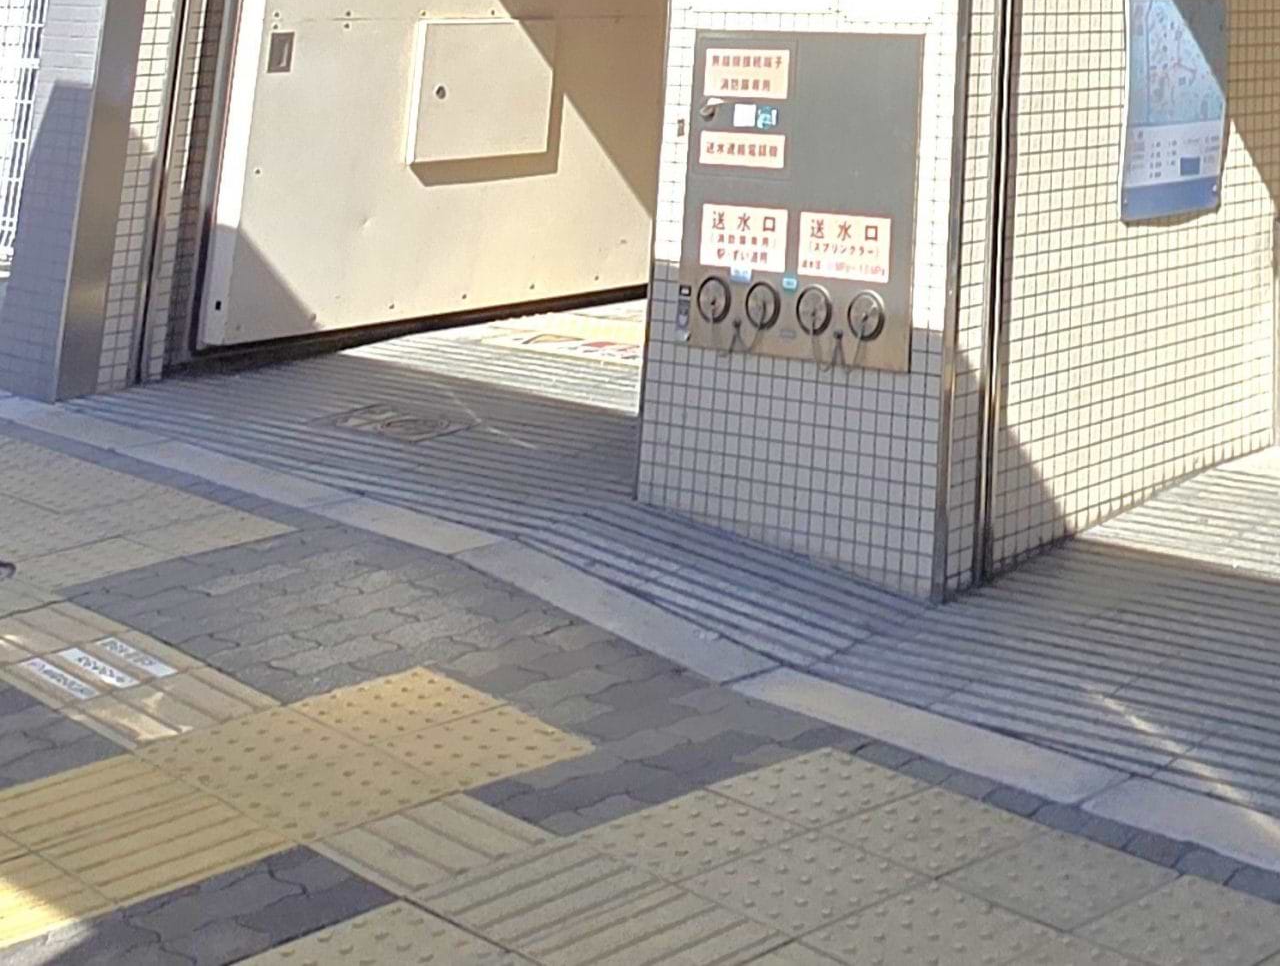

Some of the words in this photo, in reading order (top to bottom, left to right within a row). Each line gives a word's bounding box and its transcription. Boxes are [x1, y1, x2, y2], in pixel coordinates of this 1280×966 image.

[712, 211, 776, 232] 送水口
[810, 219, 878, 241] 送水口
